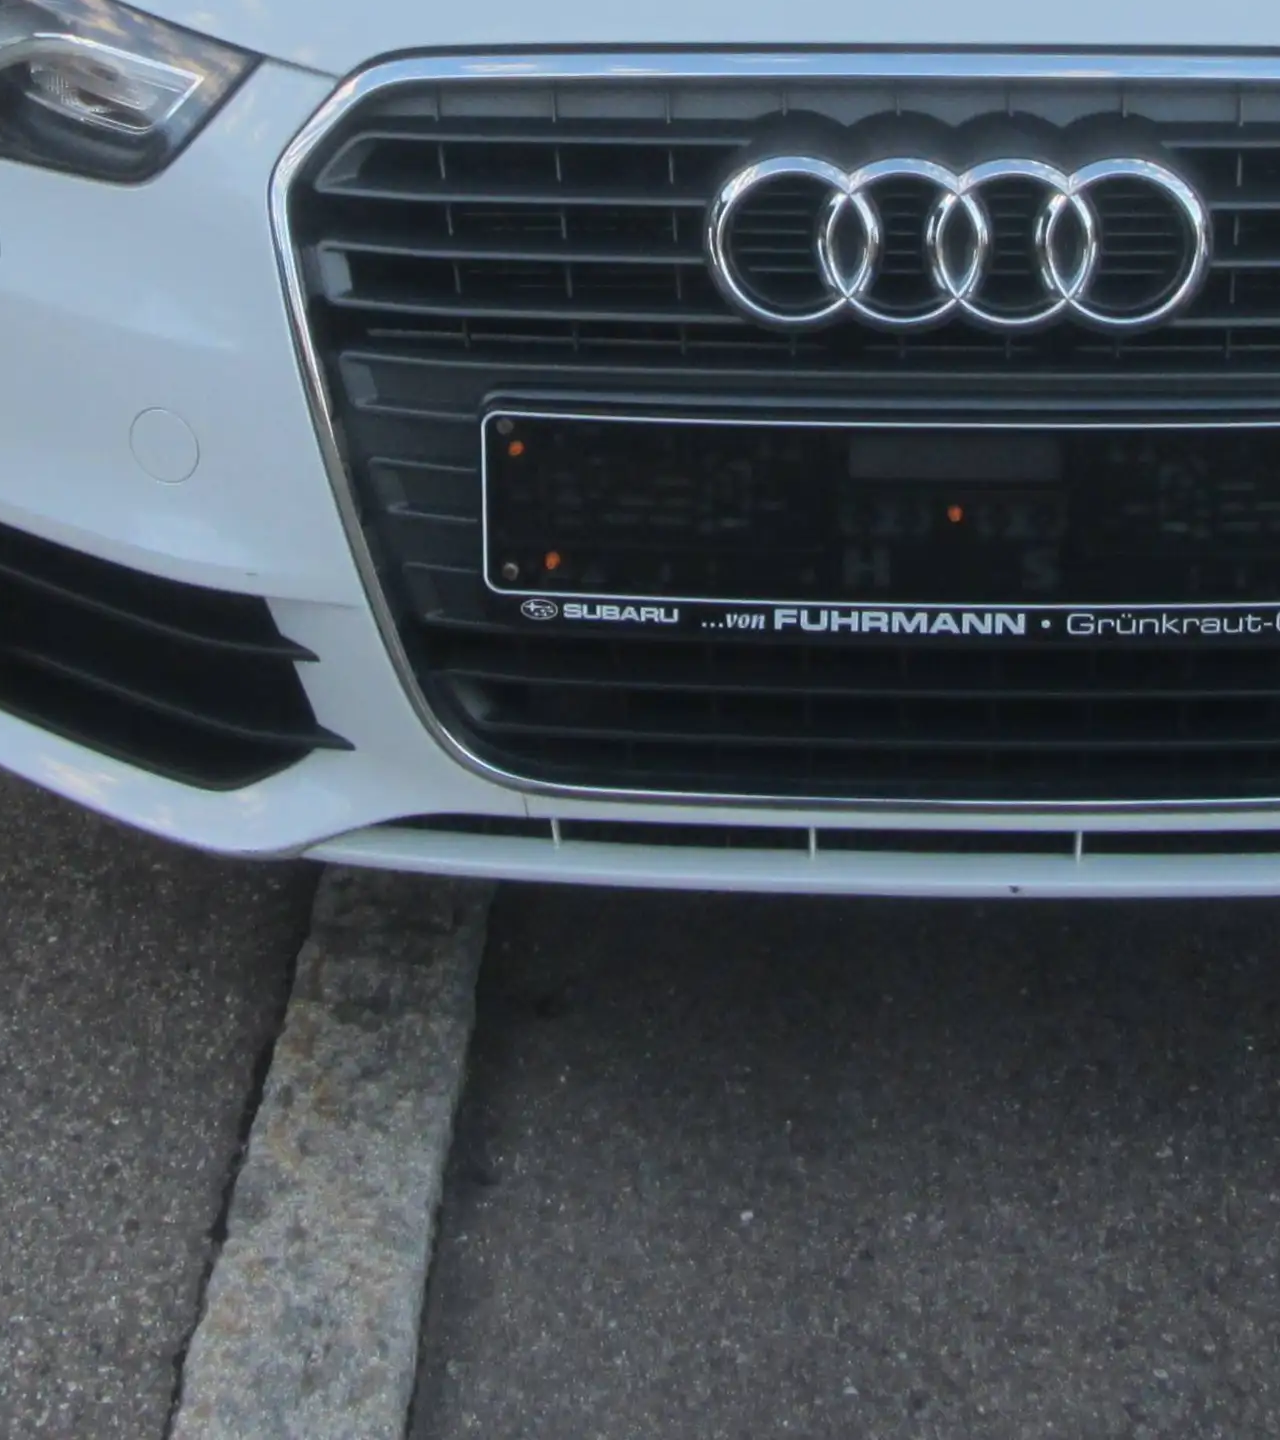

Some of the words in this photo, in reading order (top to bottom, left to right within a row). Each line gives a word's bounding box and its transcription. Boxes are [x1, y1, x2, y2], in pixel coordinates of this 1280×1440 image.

[563, 603, 680, 624] SUBARU
[701, 610, 766, 630] ...von
[774, 608, 1026, 636] FUHRMANN
